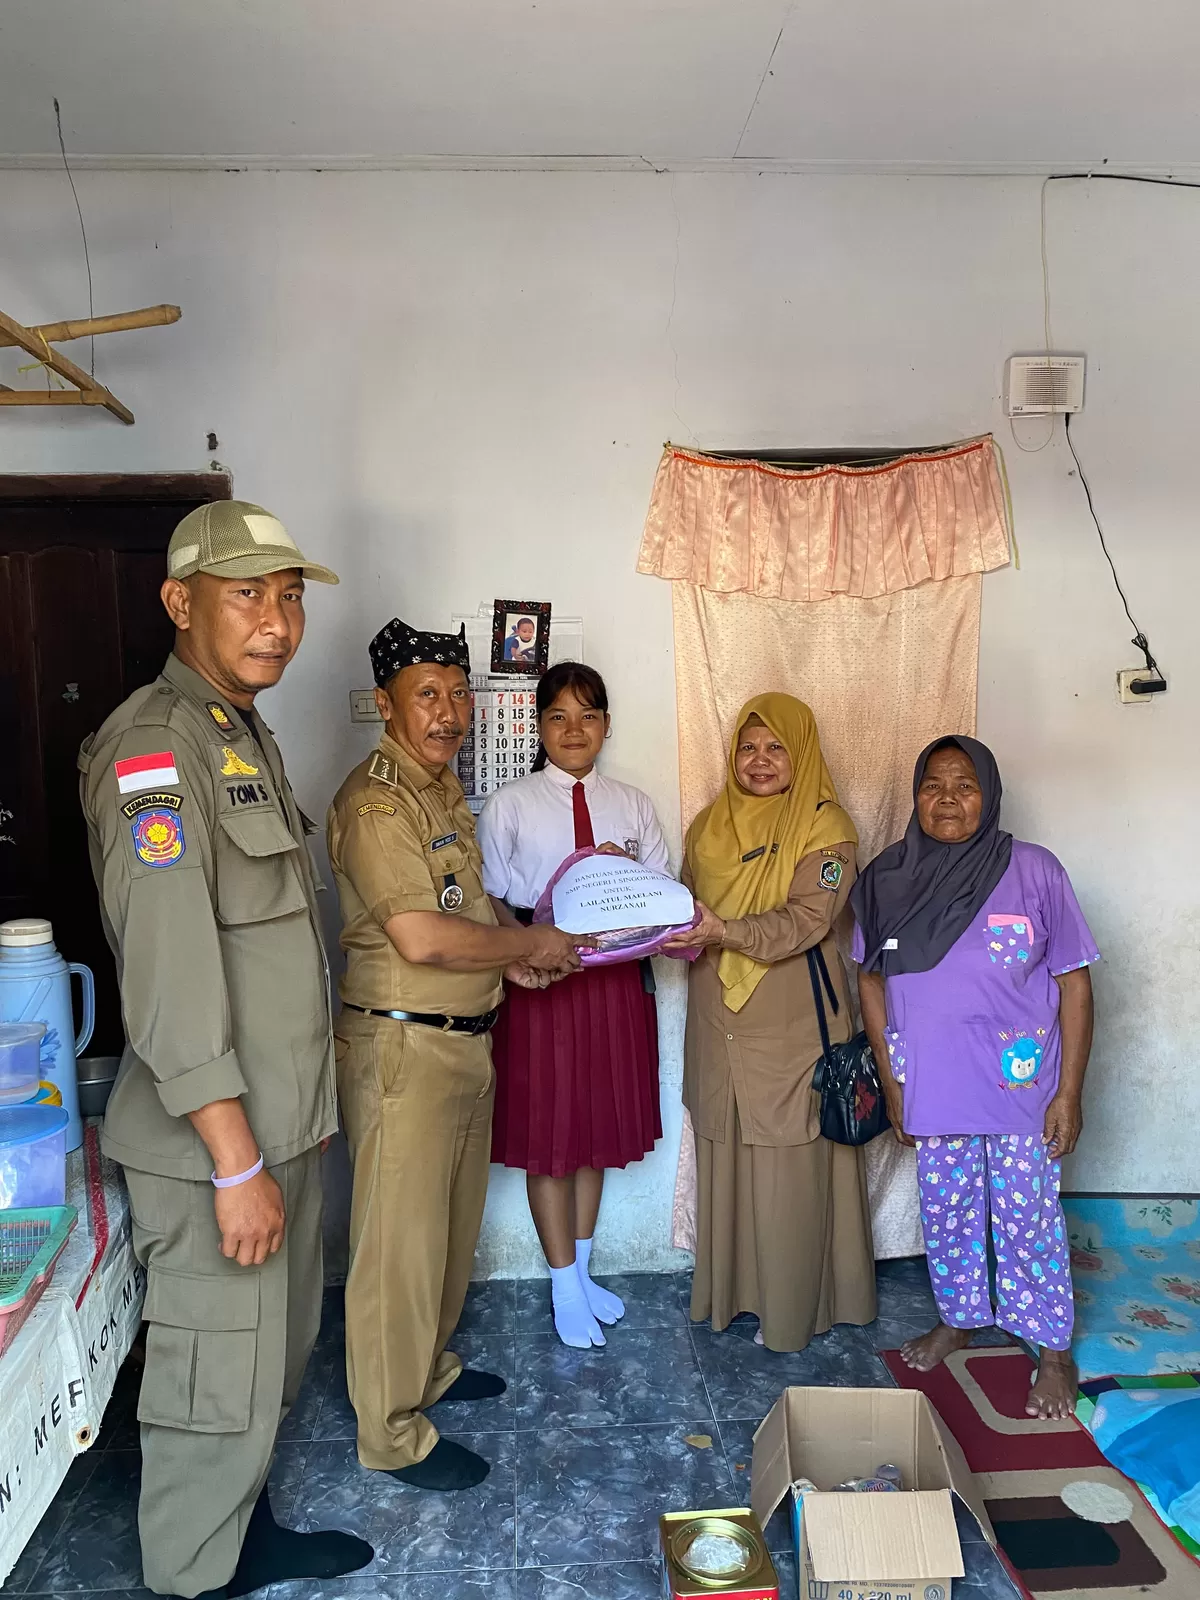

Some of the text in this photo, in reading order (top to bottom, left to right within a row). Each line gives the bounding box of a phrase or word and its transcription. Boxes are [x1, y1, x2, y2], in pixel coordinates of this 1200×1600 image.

[497, 693, 505, 705] 7
[512, 693, 525, 705] 14
[529, 693, 536, 705] 2
[480, 708, 536, 720] 1 8 15 2
[480, 723, 488, 734] 2
[497, 723, 505, 735] 9
[512, 723, 525, 735] 16
[480, 737, 488, 749] 3
[495, 737, 508, 749] 10
[512, 737, 525, 749] 17
[480, 752, 488, 764] 4
[495, 752, 508, 764] 11
[512, 752, 526, 764] 18
[529, 752, 537, 764] 2
[480, 767, 488, 779] 5
[495, 767, 508, 779] 12
[512, 767, 526, 779] 19
[257, 782, 269, 802] S
[480, 782, 488, 793] 6
[125, 795, 179, 815] KEMENDAGRI
[574, 870, 613, 883] BANTUAN
[582, 879, 612, 889] NEGERI
[580, 890, 663, 908] LAILATUL MAELANI
[600, 901, 647, 913] NURZANAH
[837, 1588, 853, 1600] 40
[857, 1592, 865, 1600] x
[896, 1591, 912, 1600] ml
